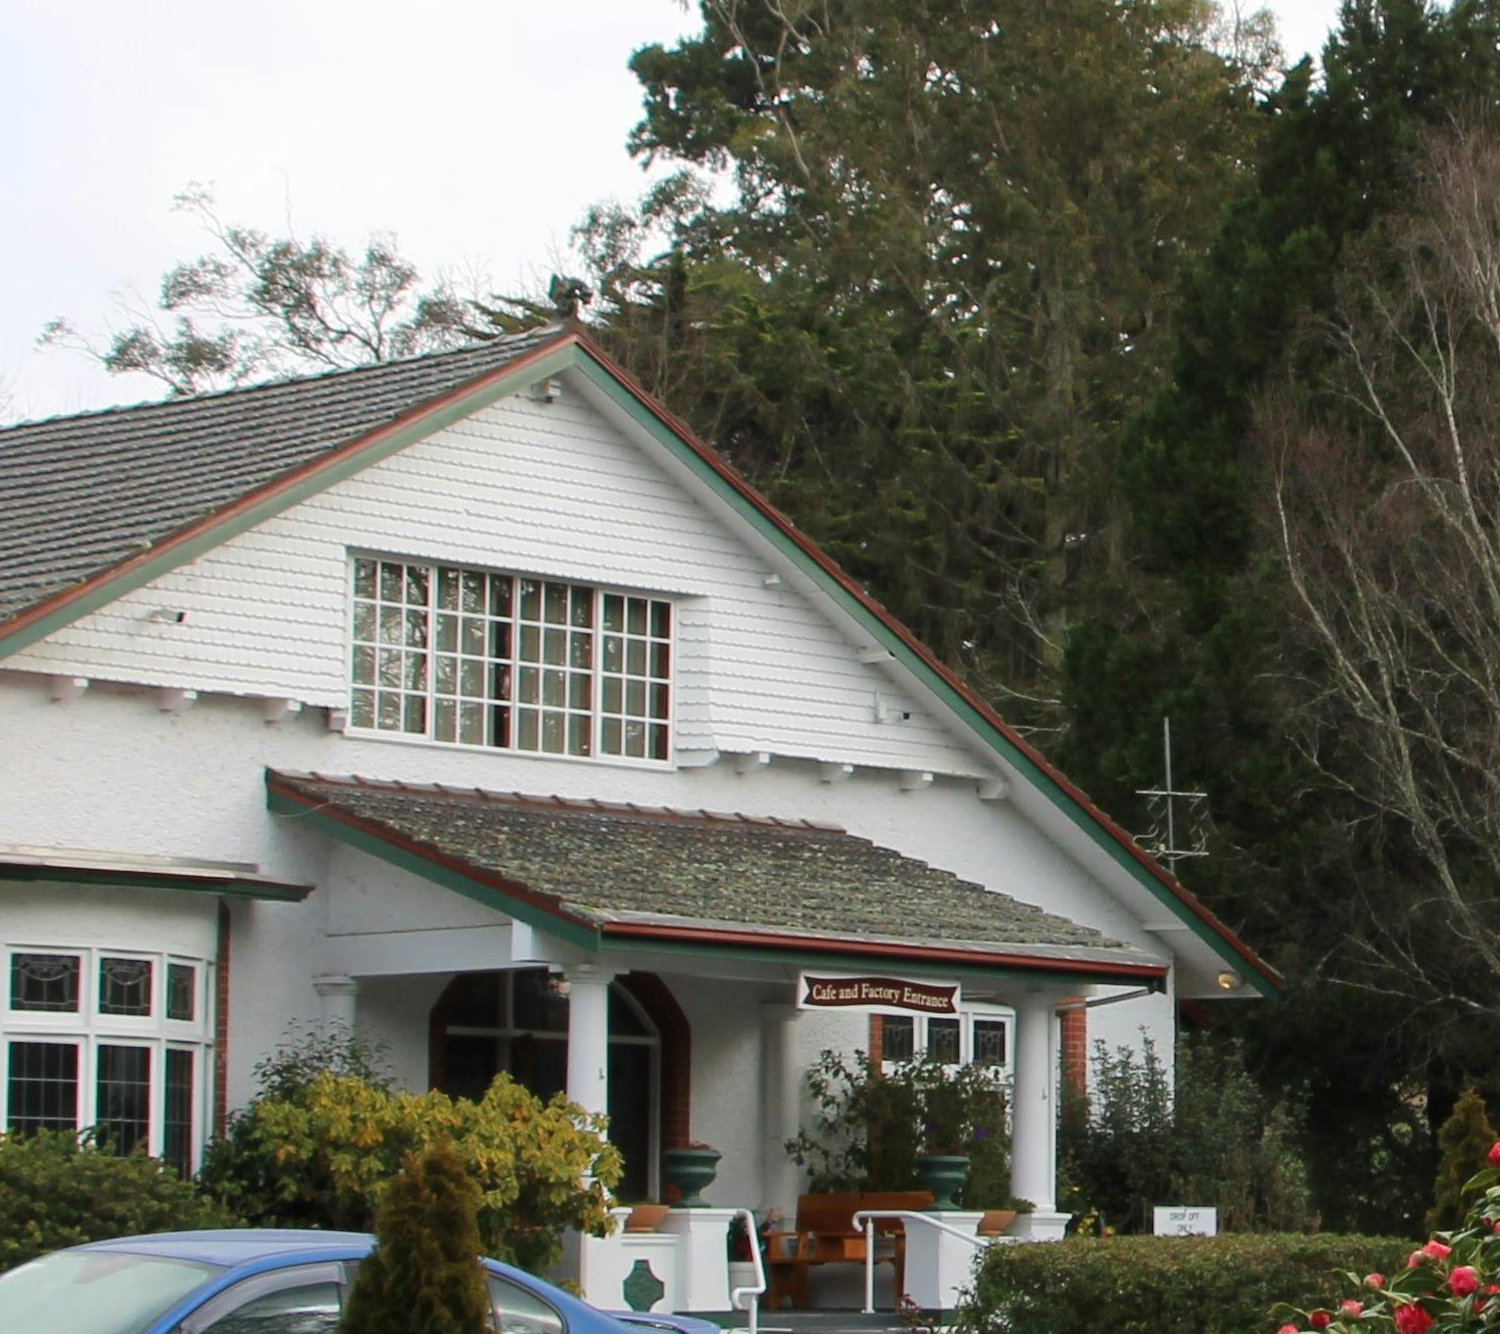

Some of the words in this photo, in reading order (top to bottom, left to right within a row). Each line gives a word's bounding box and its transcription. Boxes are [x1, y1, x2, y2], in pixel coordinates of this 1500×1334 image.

[812, 984, 837, 1000] Cafe
[838, 984, 859, 1000] and
[861, 983, 901, 1004] Factory
[903, 987, 949, 1008] Entrance
